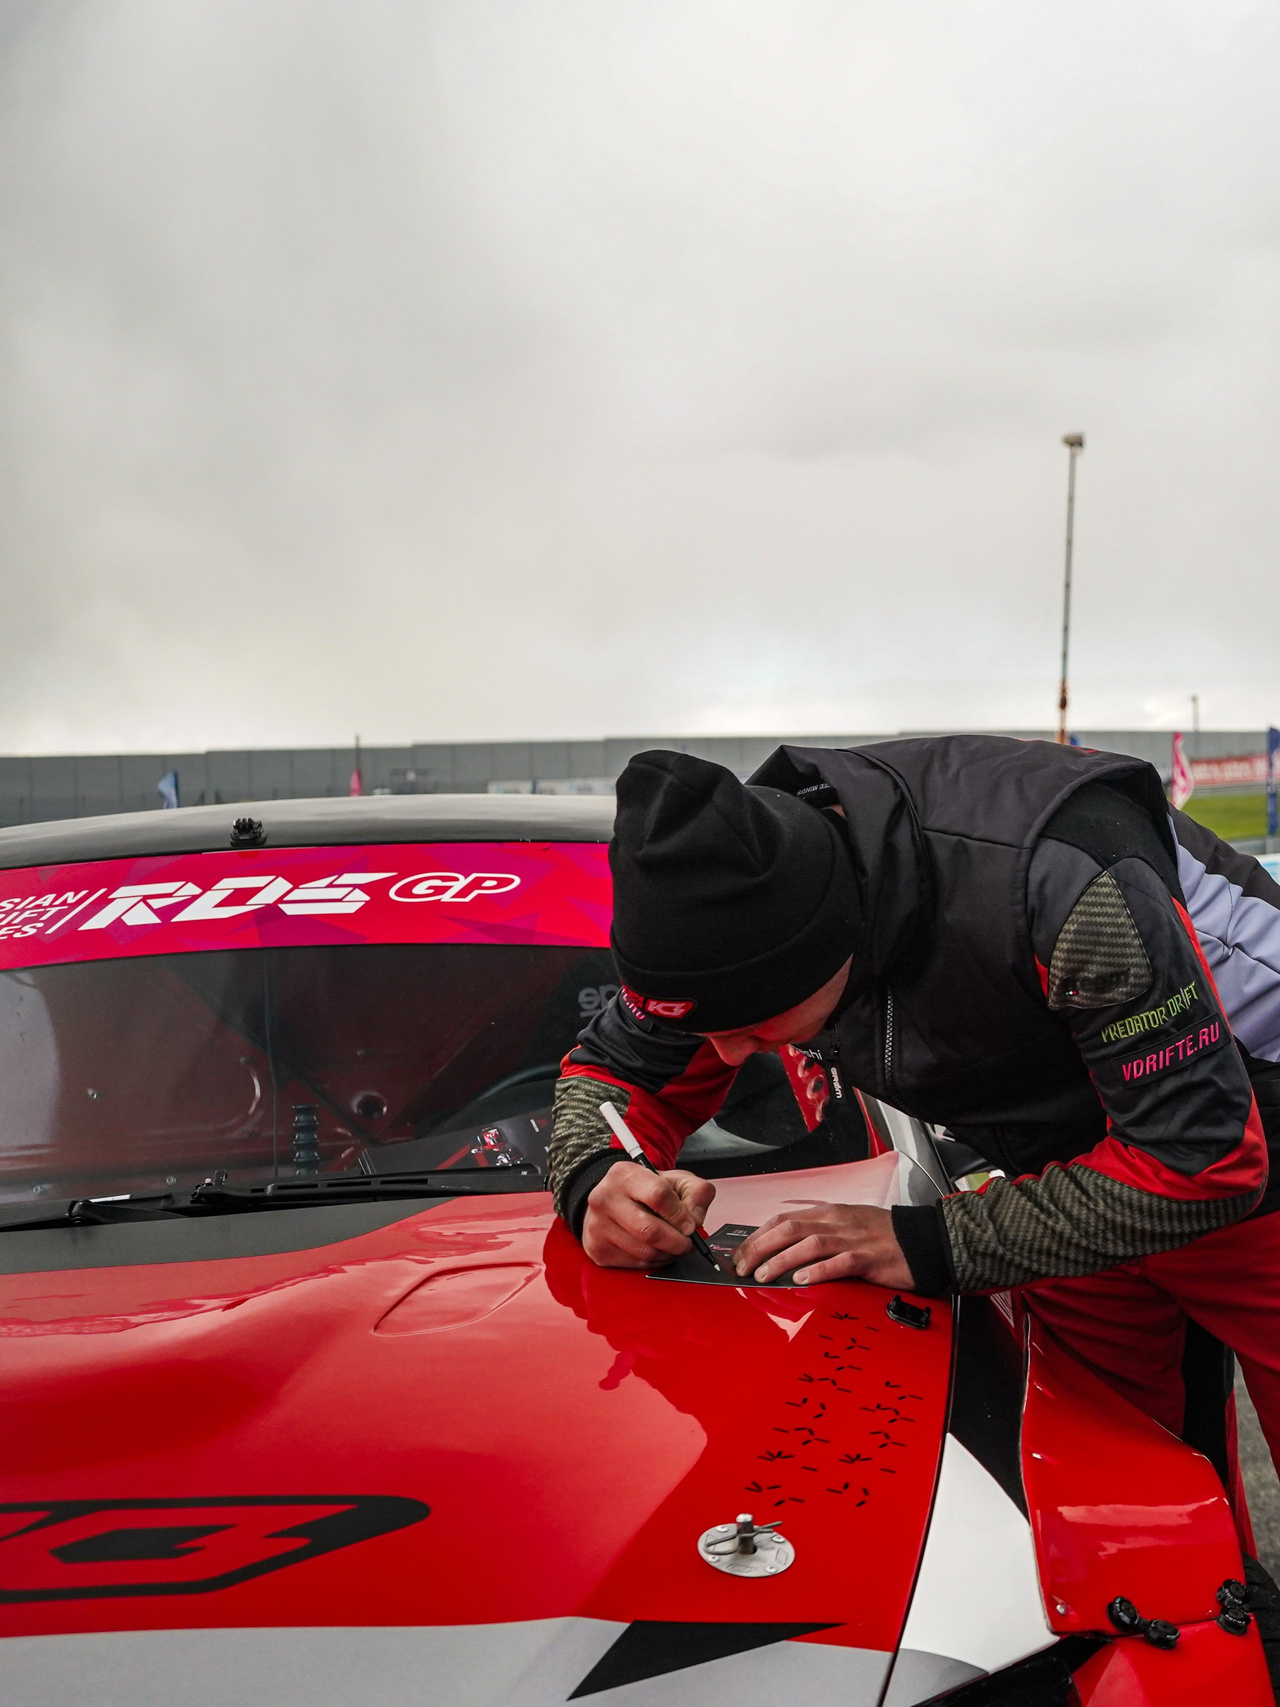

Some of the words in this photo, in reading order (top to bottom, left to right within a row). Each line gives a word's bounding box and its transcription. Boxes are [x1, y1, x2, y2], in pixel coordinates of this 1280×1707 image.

[77, 872, 399, 931] RDS
[388, 871, 521, 903] GP
[1101, 1006, 1169, 1043] PREDATOR
[1167, 980, 1199, 1017] DRIFT
[1121, 1021, 1220, 1082] VDRIFTE.RU
